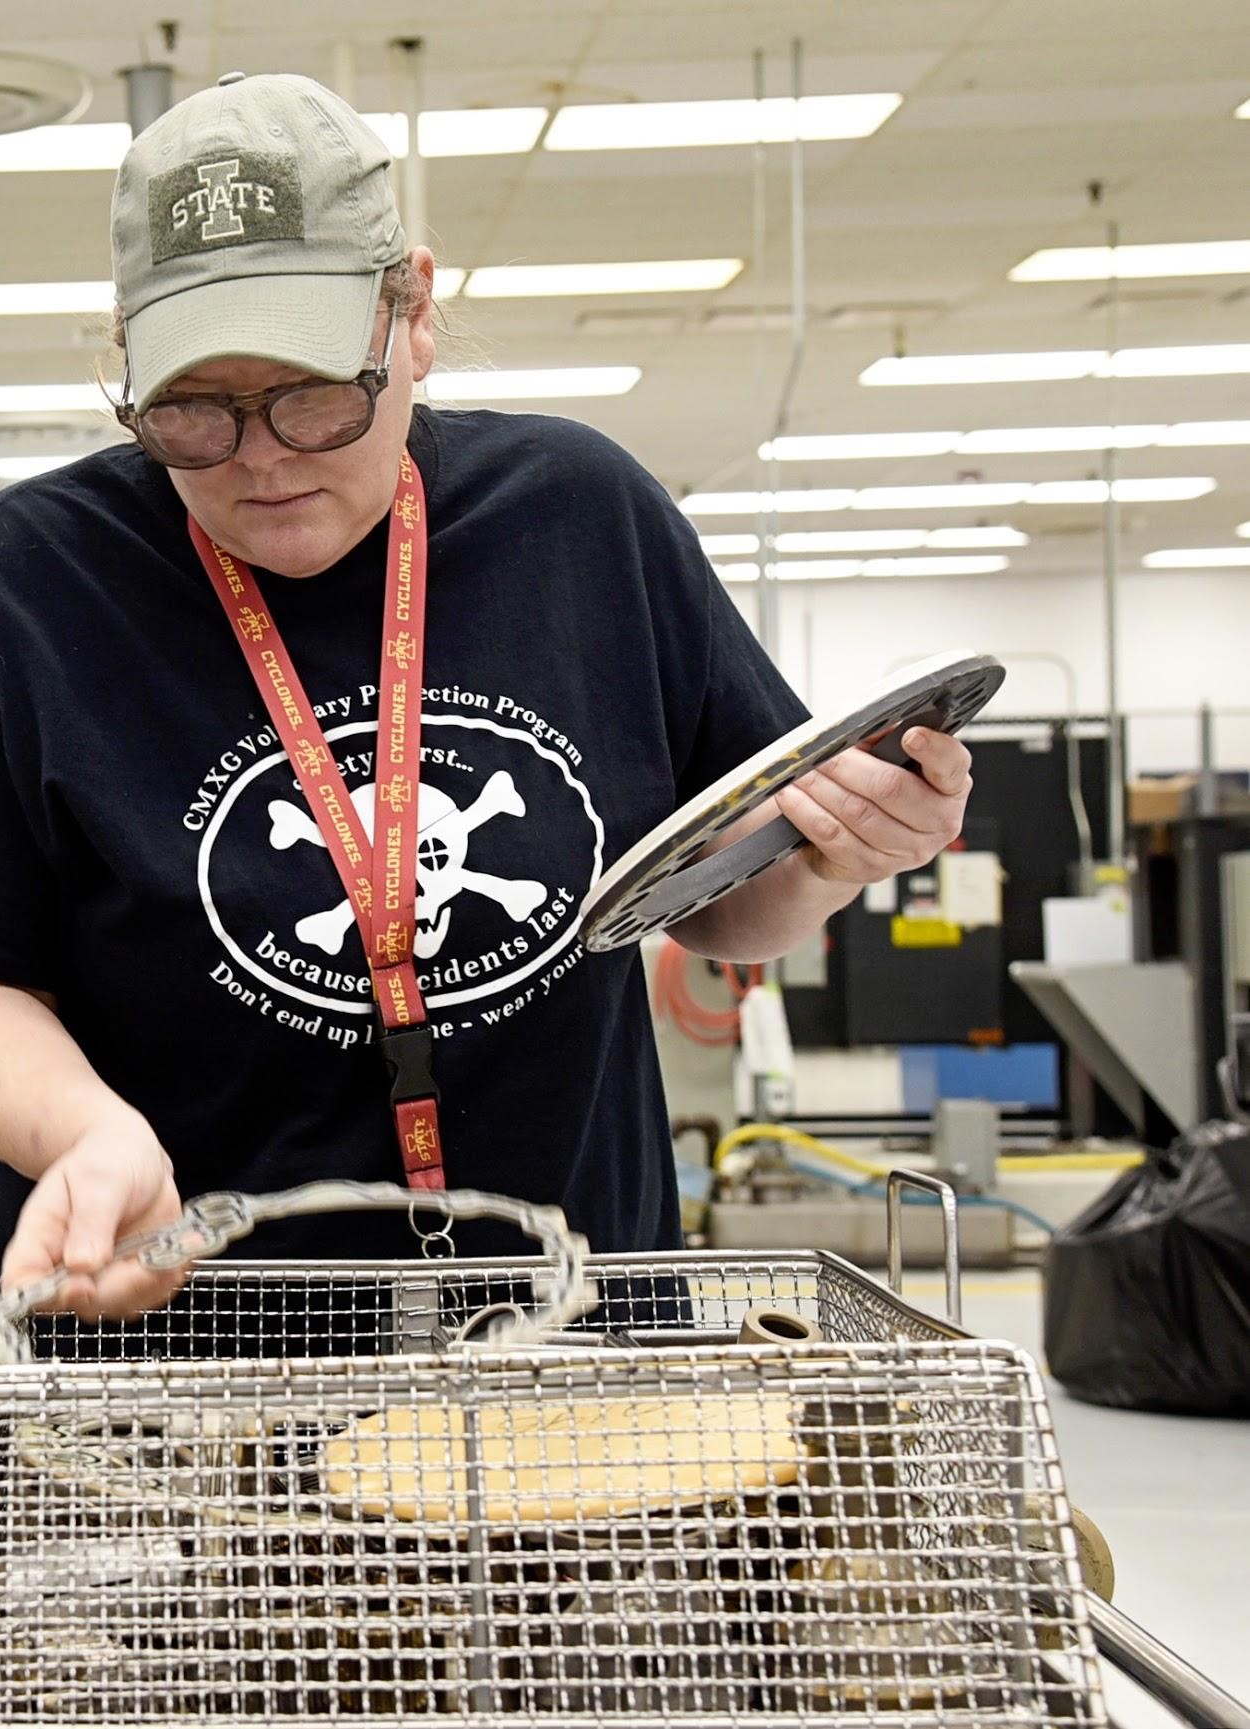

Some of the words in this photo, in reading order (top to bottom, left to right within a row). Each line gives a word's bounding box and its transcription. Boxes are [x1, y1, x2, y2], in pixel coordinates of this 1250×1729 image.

[171, 182, 276, 230] STATE
[402, 492, 415, 530] STATE
[239, 606, 264, 642] STATE
[396, 631, 410, 670] STATE
[183, 751, 242, 831] CMXG
[237, 697, 351, 755] Volary
[359, 685, 490, 710] Pection
[494, 696, 583, 767] Program
[297, 738, 322, 777] STATE
[421, 748, 474, 773] rst...
[390, 774, 405, 813] STATE
[255, 930, 372, 994] because
[416, 936, 529, 991] cidents
[526, 887, 575, 940] last
[386, 921, 401, 963] STATE
[209, 960, 273, 1016] Don't
[276, 1011, 323, 1036] end
[328, 1026, 358, 1050] up
[480, 988, 535, 1025] wear
[540, 943, 583, 995] your
[414, 1117, 432, 1162] STATE
